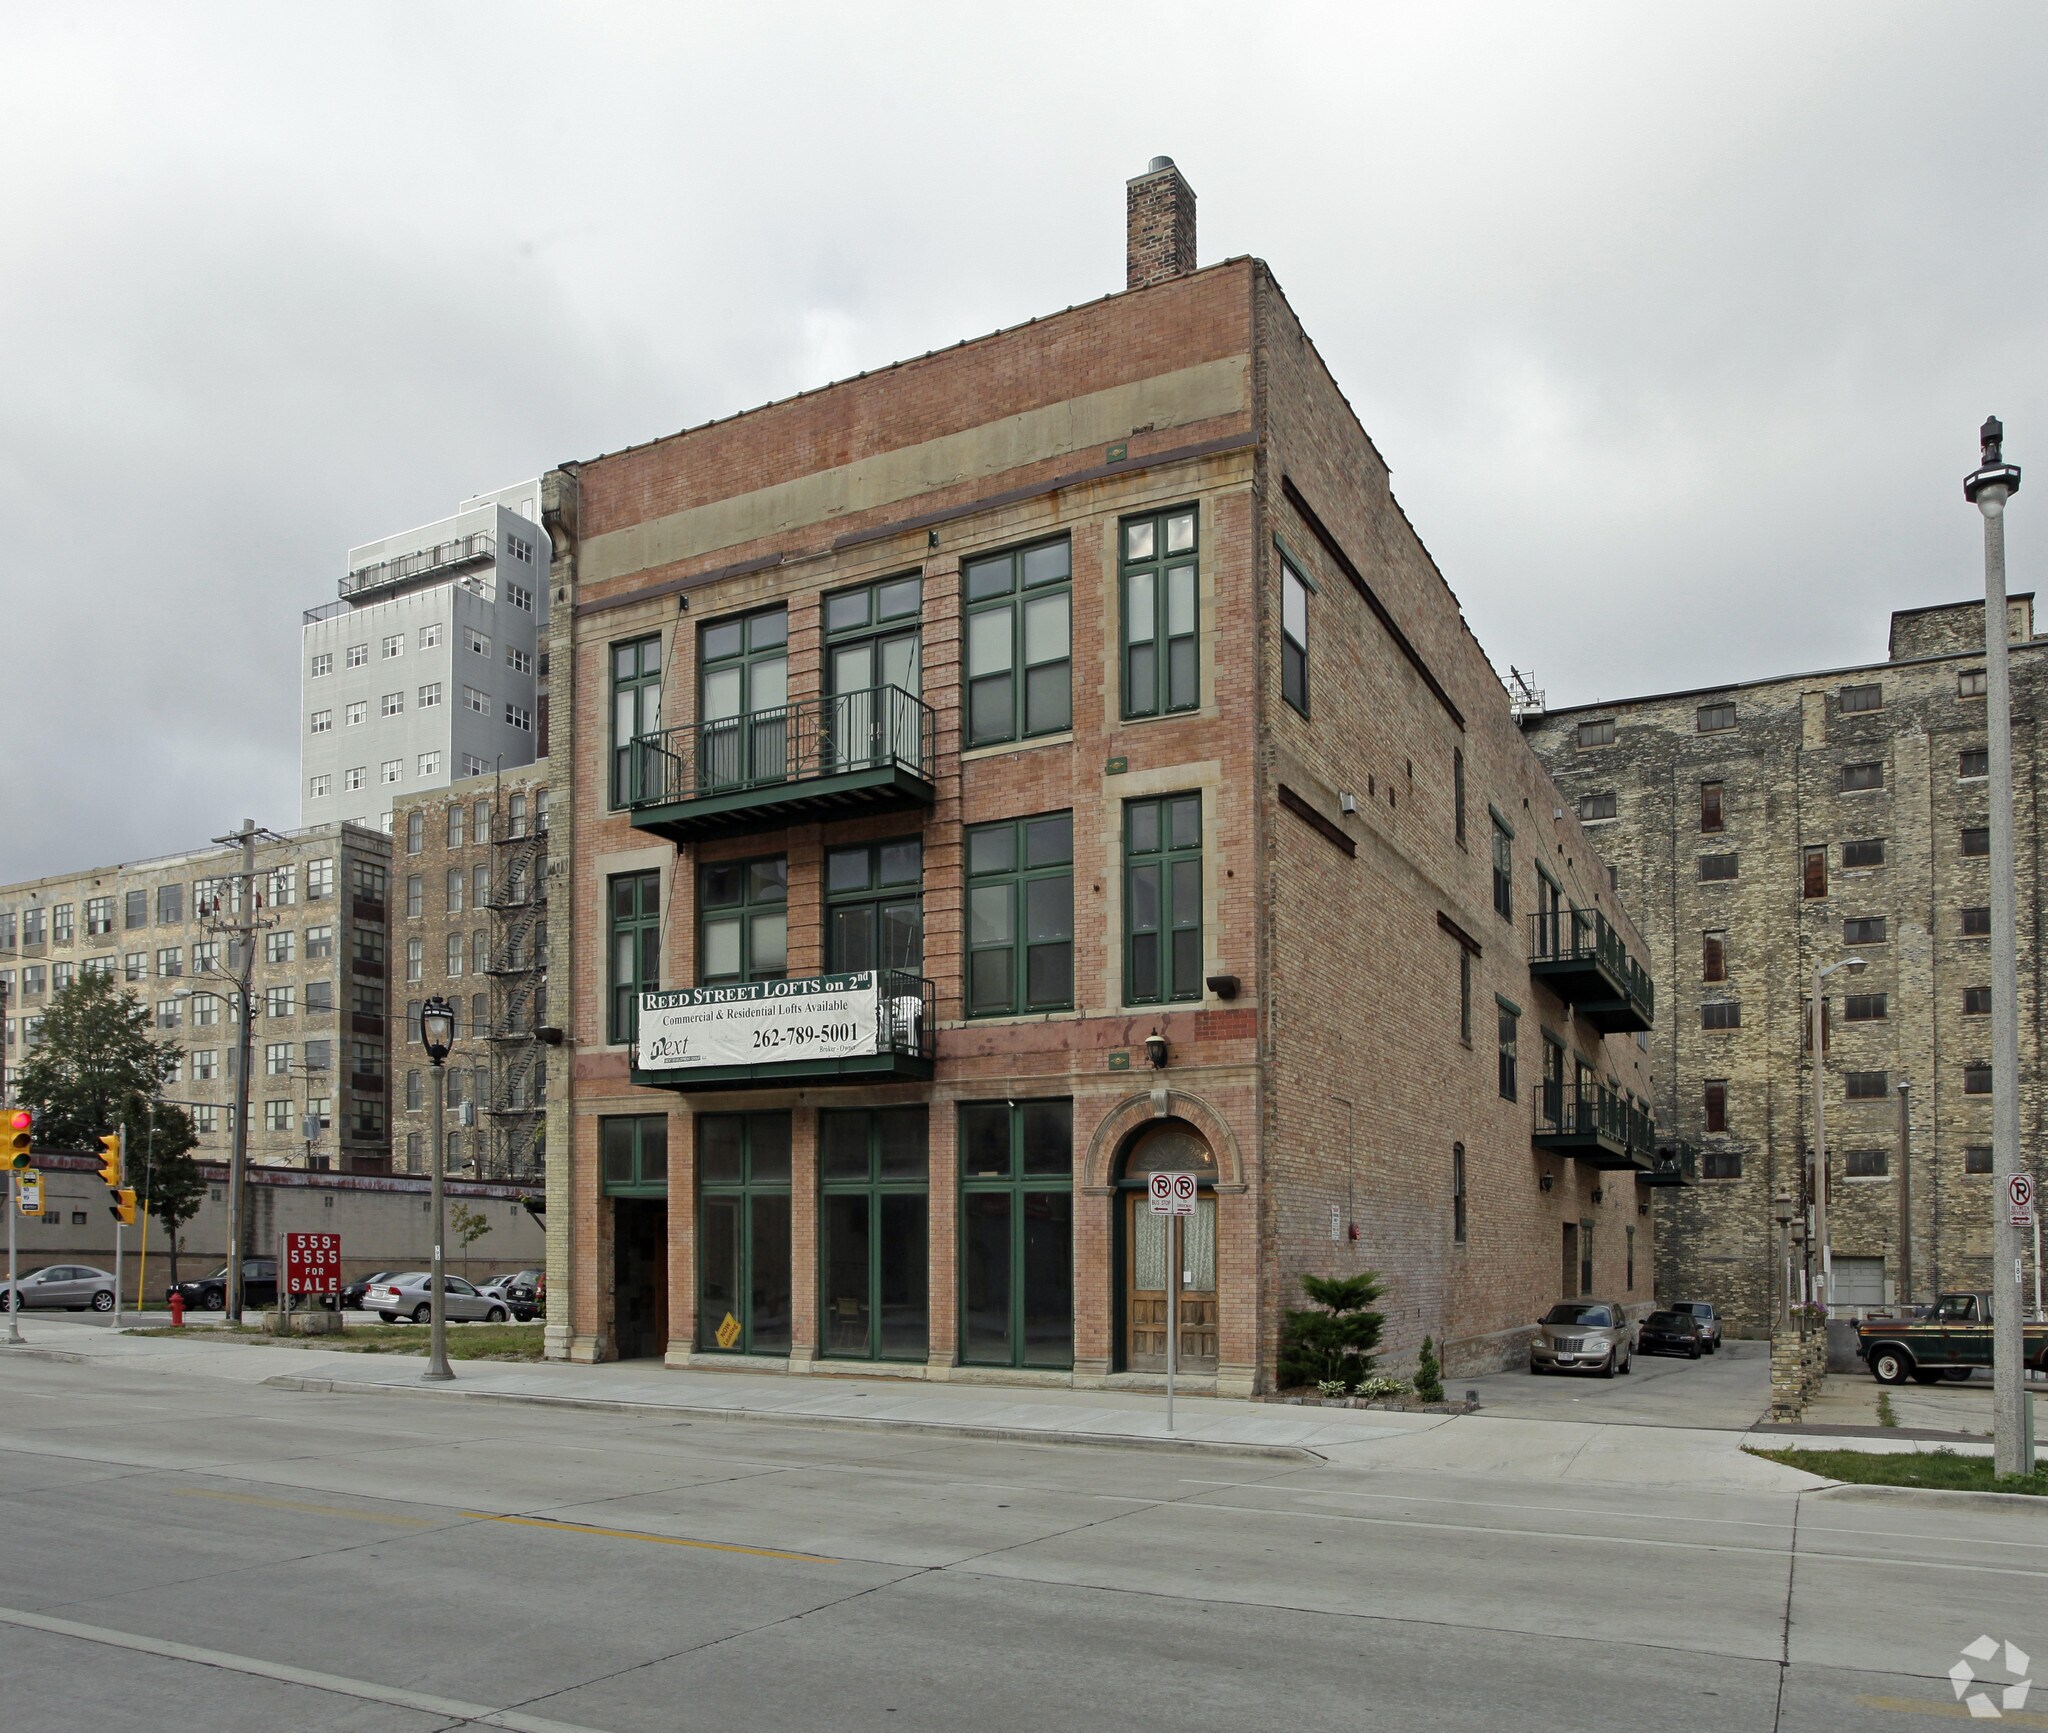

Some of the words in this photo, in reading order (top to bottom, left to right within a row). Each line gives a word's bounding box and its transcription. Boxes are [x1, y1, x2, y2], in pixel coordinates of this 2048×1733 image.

[645, 993, 690, 1010] REED
[693, 986, 760, 1005] STREET
[763, 979, 821, 998] LOFTS
[825, 981, 844, 992] on
[662, 1010, 714, 1027] Commercial
[716, 1009, 724, 1020] &
[727, 1004, 776, 1020] Residential
[778, 1002, 802, 1015] Lofts
[804, 999, 848, 1013] Available
[752, 1022, 859, 1049] 262-789-5001
[819, 1045, 836, 1053] Broker
[290, 1250, 337, 1264] 5555
[305, 1267, 324, 1275] FOR
[291, 1278, 338, 1291] SALE
